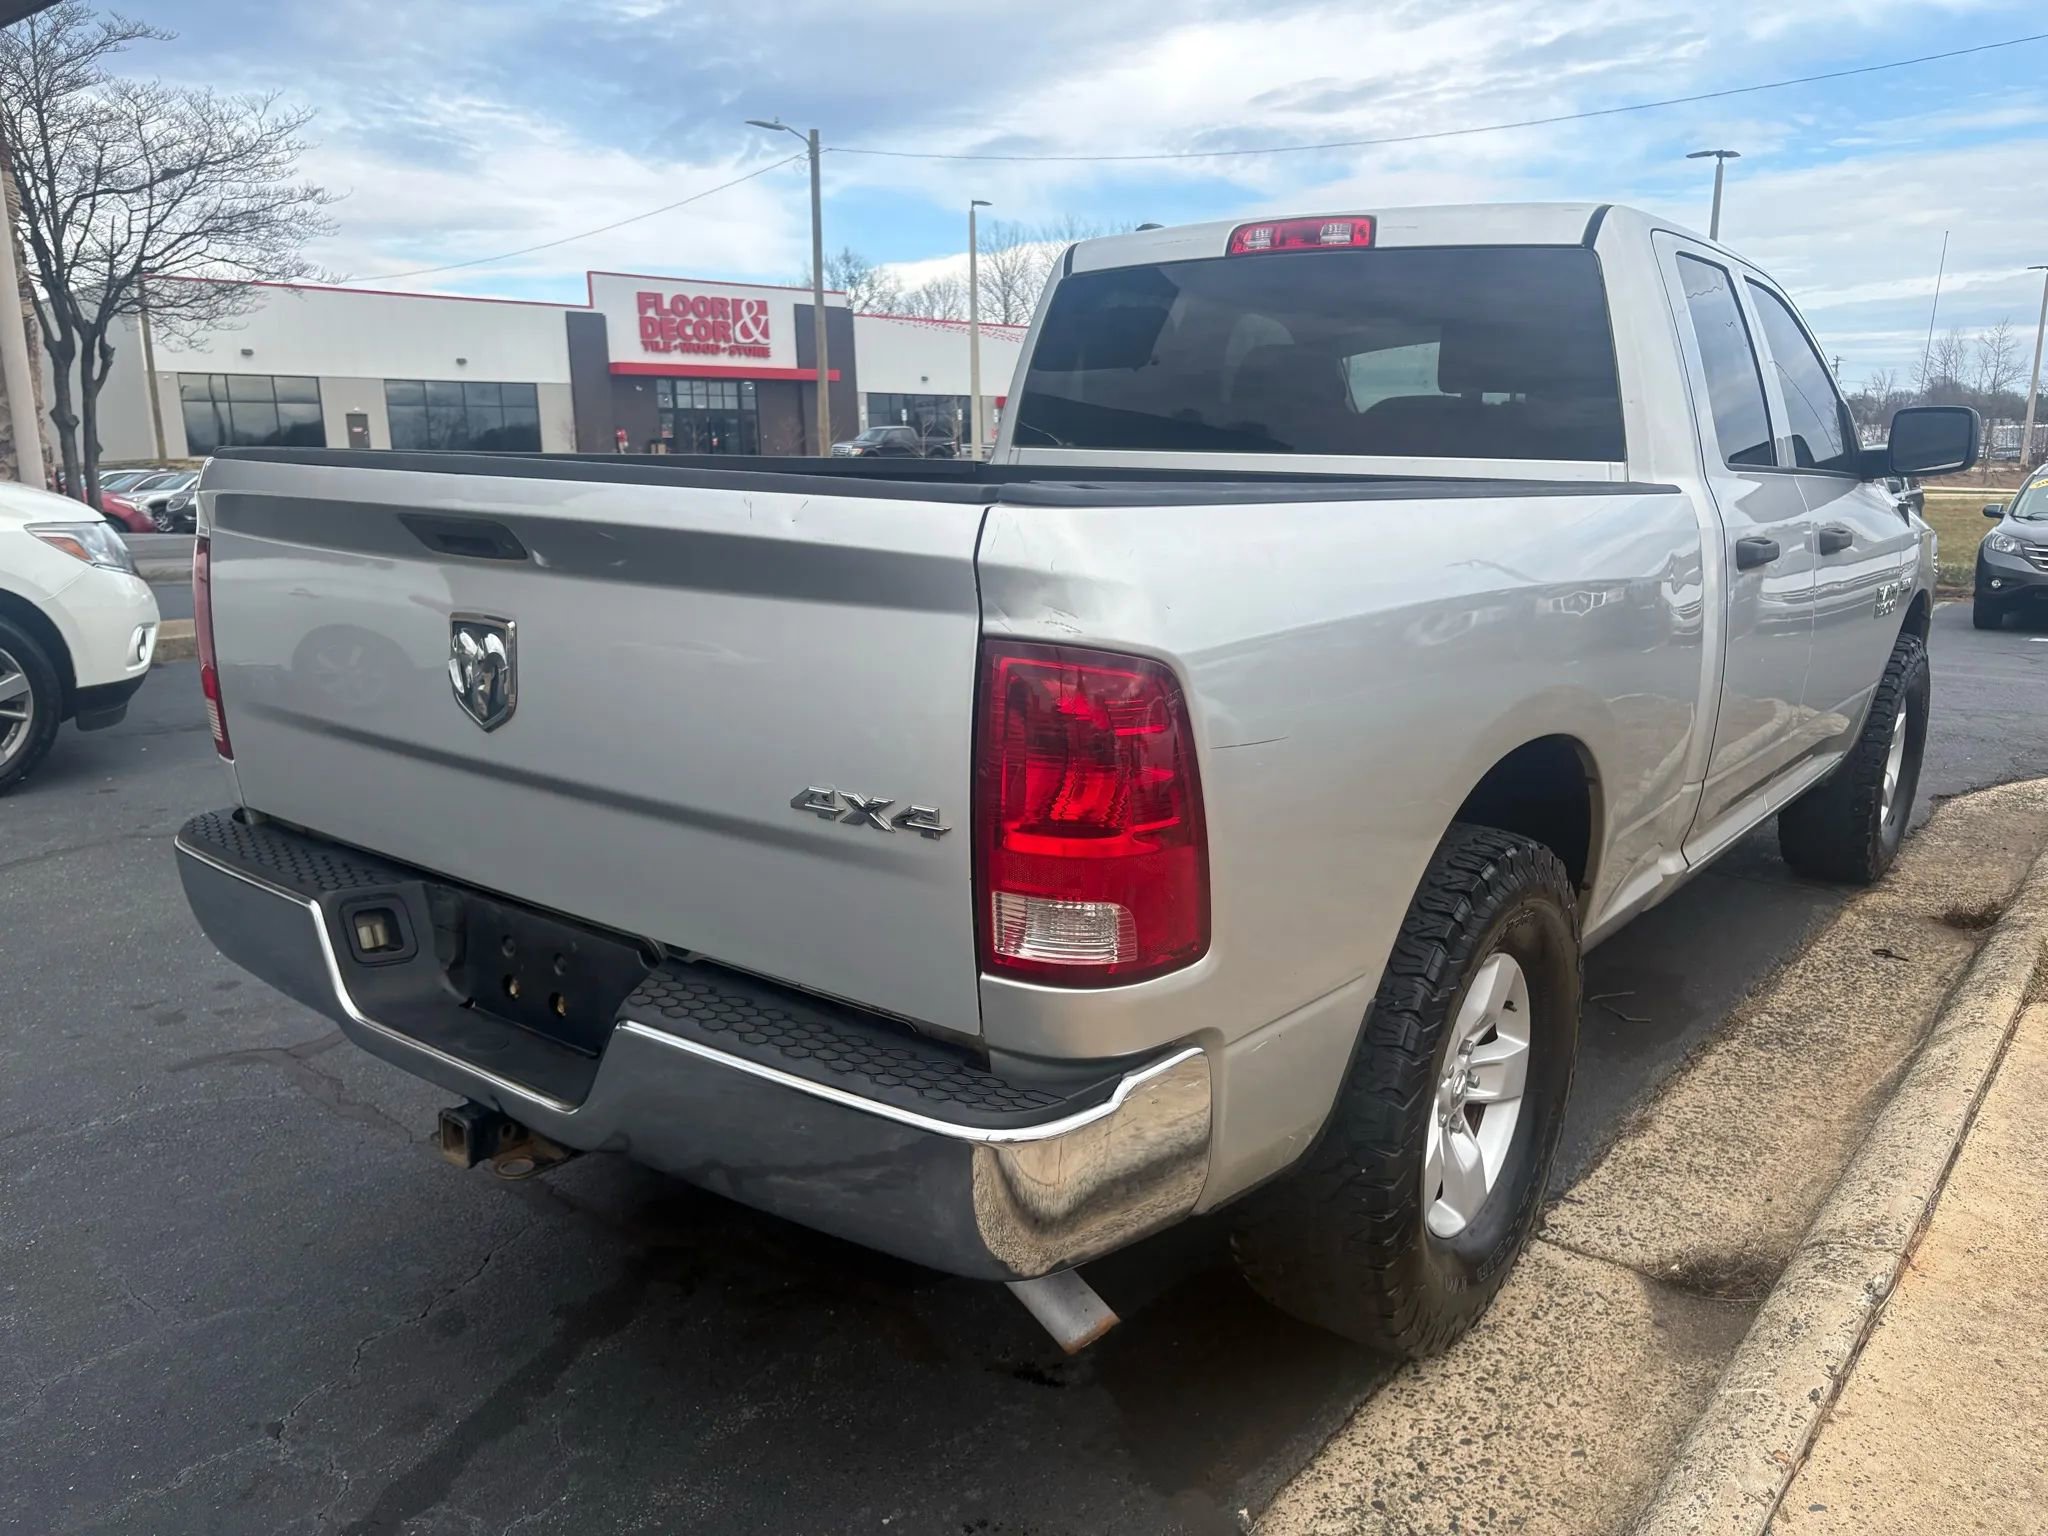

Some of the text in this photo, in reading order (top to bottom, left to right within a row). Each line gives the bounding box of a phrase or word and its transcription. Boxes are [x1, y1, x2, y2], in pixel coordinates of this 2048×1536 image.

[636, 291, 771, 345] FLOOR &
[639, 316, 732, 343] DECOR
[640, 340, 771, 358] TILE WOOD STONE
